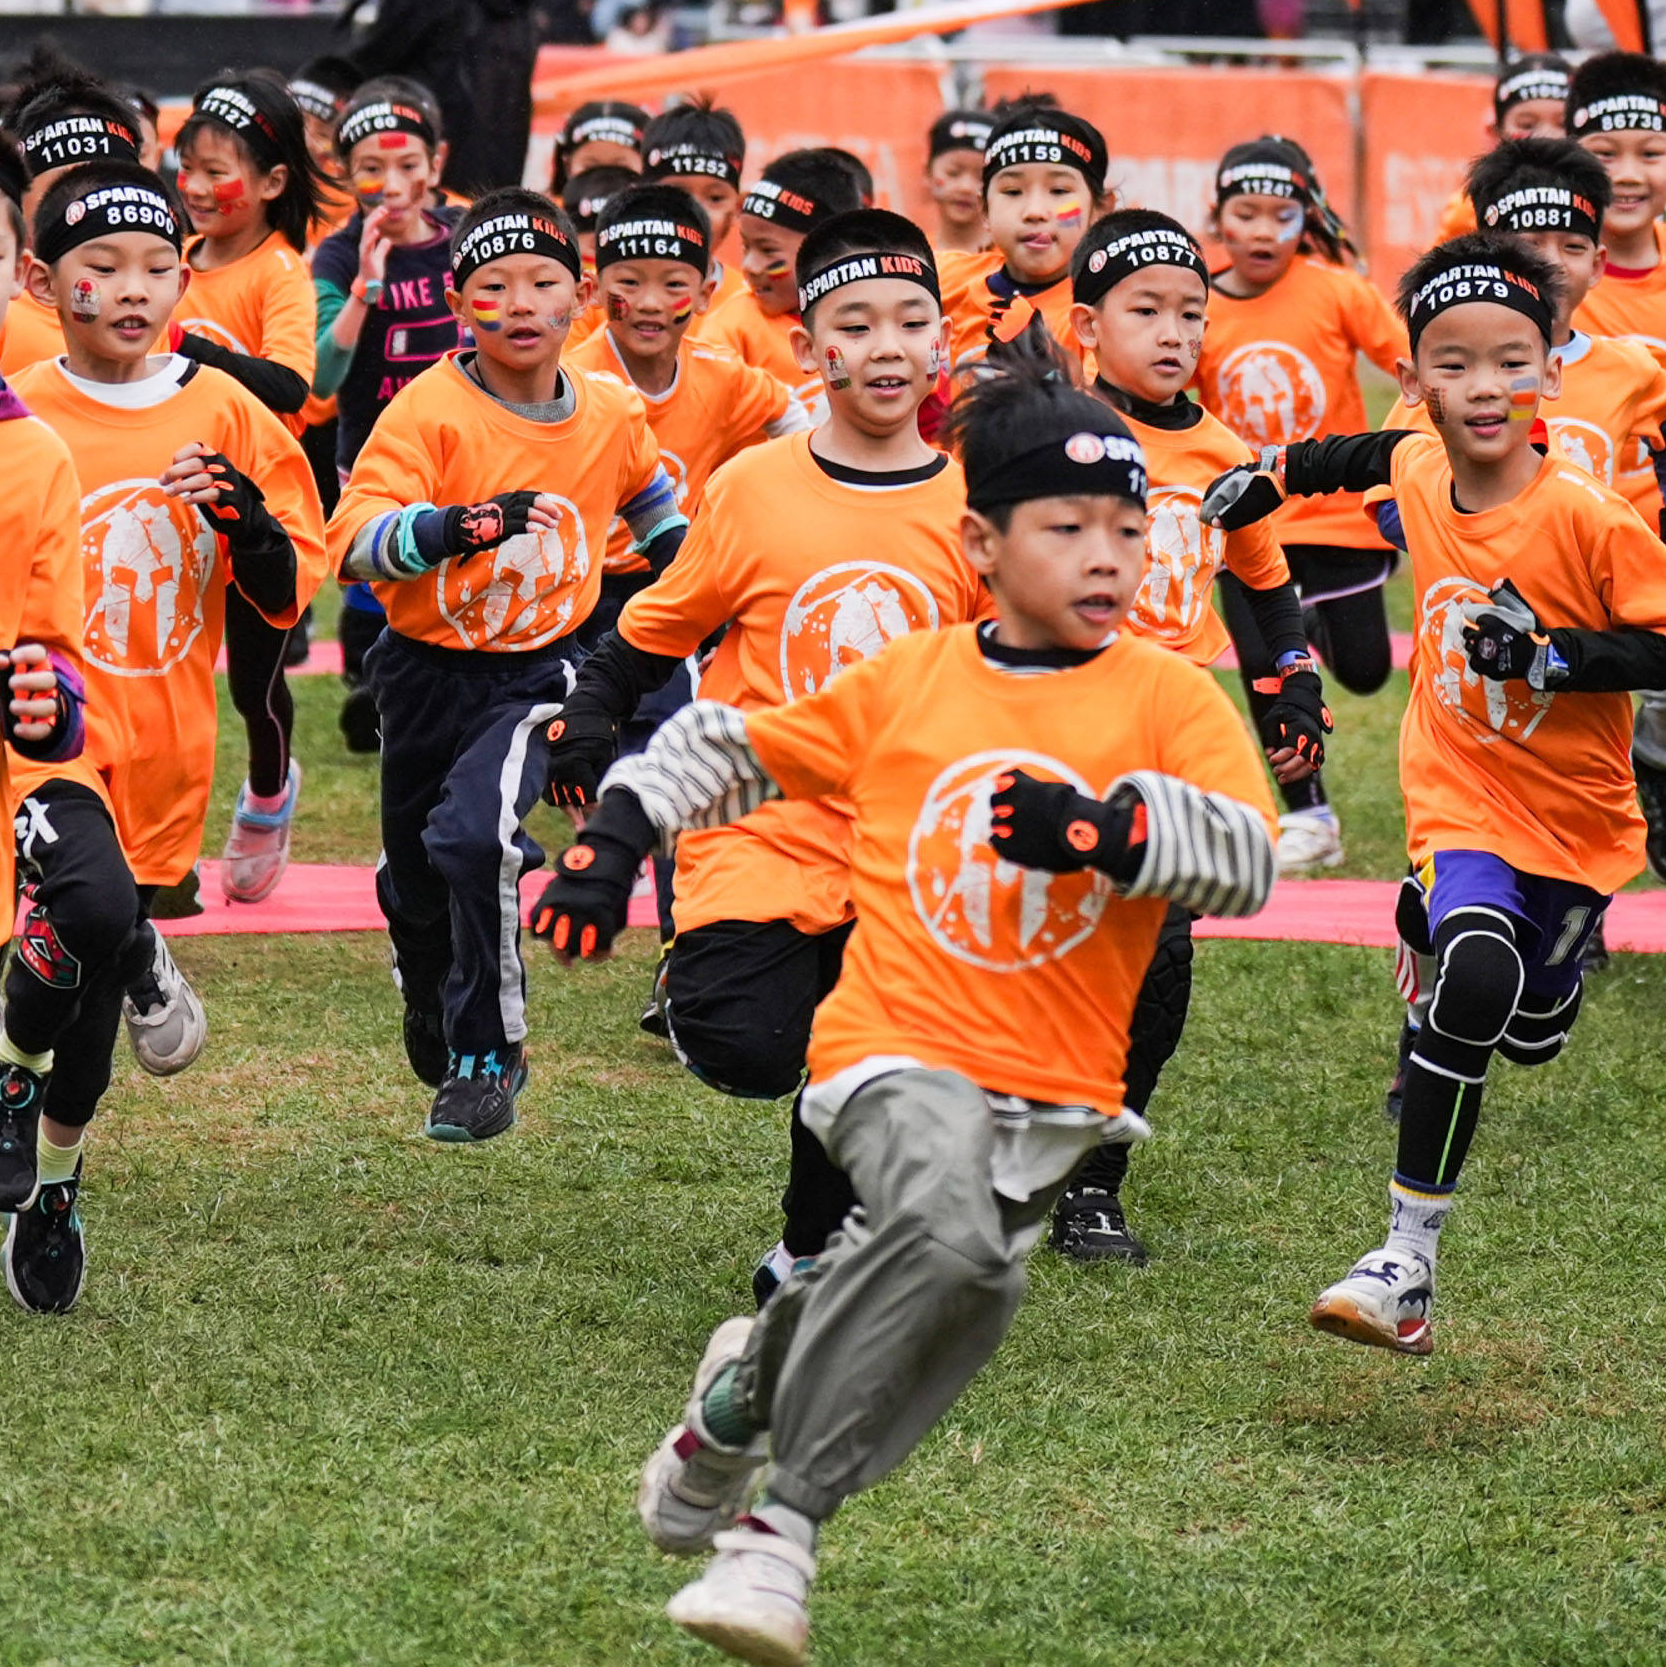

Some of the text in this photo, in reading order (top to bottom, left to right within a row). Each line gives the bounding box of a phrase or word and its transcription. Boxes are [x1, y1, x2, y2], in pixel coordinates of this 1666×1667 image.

[200, 99, 252, 130] 11127
[1587, 95, 1659, 120] SPARTAN
[25, 117, 105, 152] SPARTAN
[990, 130, 1059, 156] SPARTAN
[1060, 135, 1093, 164] KIDS
[41, 136, 111, 164] 11031
[999, 145, 1062, 167] 11159
[672, 158, 729, 178] 11252
[84, 186, 169, 215] SPARTAN
[779, 189, 815, 217] KIDS
[1498, 187, 1571, 216] SPARTAN
[106, 205, 176, 235] 86900
[460, 213, 568, 255] SPARTAN KIDS
[608, 220, 704, 248] SPARTAN KIDS
[1509, 209, 1573, 230] 10881
[470, 232, 536, 264] 10876
[617, 238, 683, 259] 11164
[1107, 229, 1189, 259] SPARTAN
[1126, 246, 1197, 268] 10877
[806, 256, 924, 303] SPARTAN KIDS
[1419, 264, 1541, 303] SPARTAN KIDS
[1426, 280, 1510, 311] 10879
